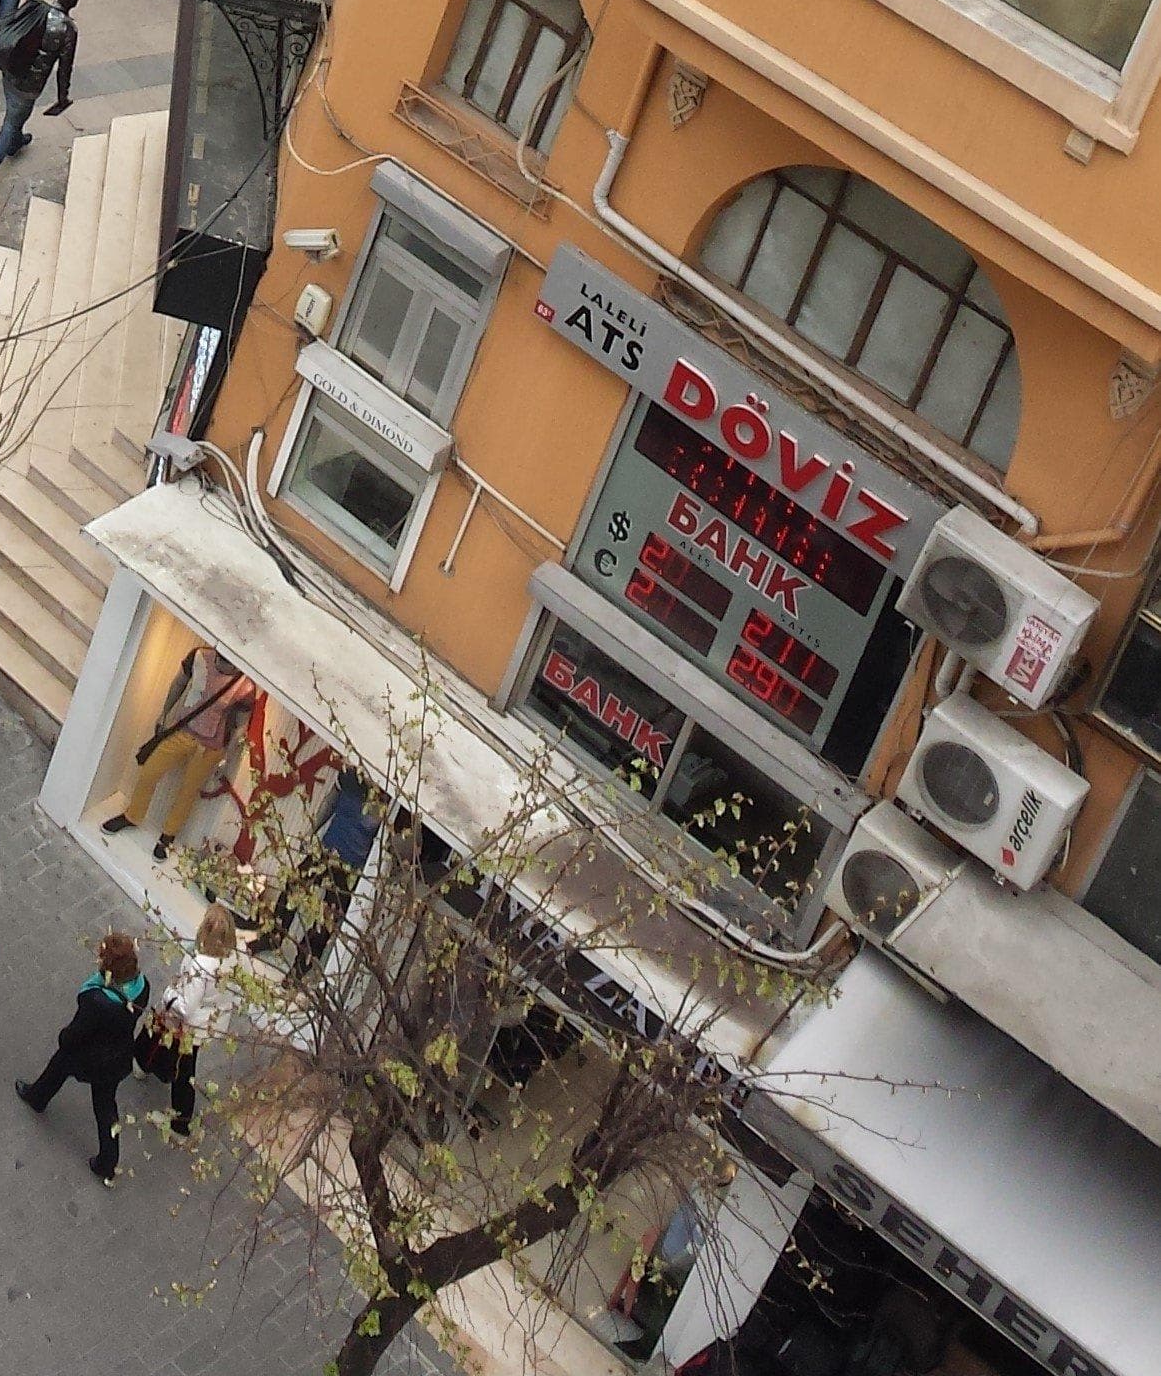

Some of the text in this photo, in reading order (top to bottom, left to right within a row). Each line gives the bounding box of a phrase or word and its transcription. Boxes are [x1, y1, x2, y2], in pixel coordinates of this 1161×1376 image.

[564, 305, 643, 370] ATS
[313, 373, 413, 453] GOLD & DIMOND
[663, 357, 909, 561] DÖVİZ
[666, 491, 811, 619] БАНК
[543, 650, 672, 769] БАНК
[1009, 789, 1042, 852] arçelik
